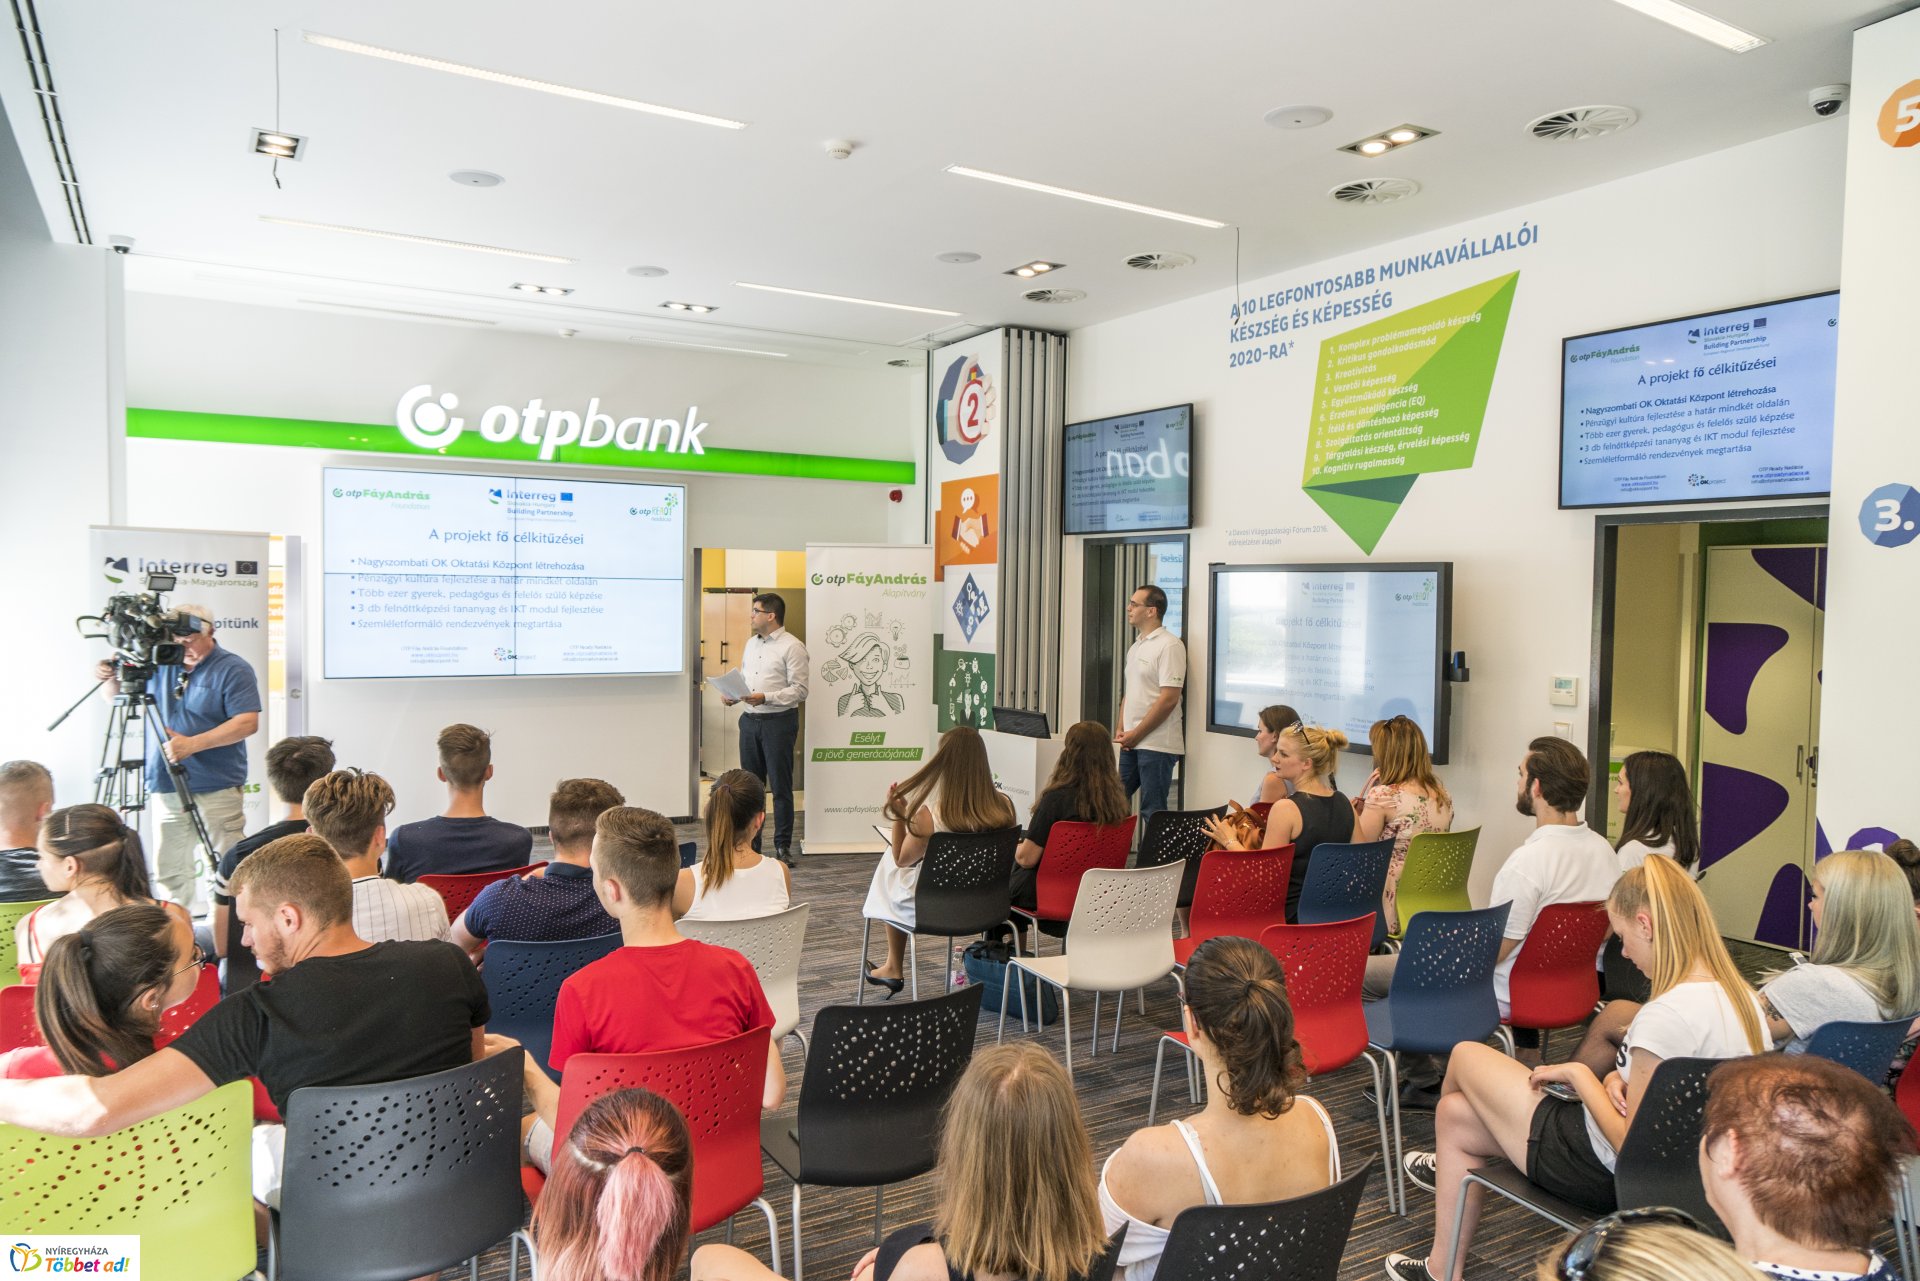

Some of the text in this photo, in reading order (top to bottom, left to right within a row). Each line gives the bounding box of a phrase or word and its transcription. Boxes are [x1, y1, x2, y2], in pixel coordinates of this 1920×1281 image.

[1242, 298, 1256, 315] 10
[1260, 268, 1375, 312] LEGFONTOSABB
[1380, 222, 1538, 281] MUNKAVÁLLALÓI
[1230, 289, 1392, 343] KÉSZSÉG ÉS KÉPESSÉG
[1338, 338, 1370, 353] Komplex
[1372, 320, 1446, 346] problémamegoldó
[1448, 312, 1481, 328] készség
[1338, 352, 1366, 366] Kritikus
[1368, 336, 1436, 361] gondolkodásmód
[1704, 341, 1729, 350] Building
[1730, 336, 1767, 346] Partnership
[1335, 363, 1376, 380] Kreativitás
[1638, 356, 1776, 386] A projekt fő célkitűzései
[1362, 374, 1396, 392] képesség
[1388, 384, 1418, 400] készség
[1358, 399, 1408, 416] intelligencia
[1409, 396, 1426, 408] (EQ)
[1586, 386, 1776, 416] Nagyszombati OK Oktatási Központ létrehozása
[968, 393, 979, 427] 2
[1586, 417, 1617, 428] Pénzügyi
[1619, 414, 1644, 424] kultúra
[1647, 410, 1685, 422] fejlesztése
[1695, 407, 1716, 416] határ
[1718, 402, 1754, 414] mindkét
[1756, 399, 1790, 409] oldalán
[1347, 422, 1354, 430] és
[1356, 416, 1400, 430] döntéshozó
[1402, 408, 1440, 424] képesség
[1652, 422, 1694, 435] pedagógus
[1708, 418, 1733, 428] felelős
[1736, 416, 1757, 424] szülő
[1760, 412, 1795, 424] képzése
[480, 396, 708, 460] otpbank
[1374, 425, 1424, 441] orientáltság
[1326, 447, 1363, 460] Tárgyalási
[1398, 434, 1430, 450] érvelési
[1432, 432, 1470, 446] képesség
[1592, 444, 1600, 452] db
[1604, 440, 1652, 450] felnőttképzési
[1656, 436, 1692, 446] tananyag
[1704, 432, 1718, 441] IKT
[1720, 430, 1749, 440] modul
[1752, 426, 1796, 438] fejlesztése
[1584, 444, 1752, 464] Szemléletformáló rendezvények megtartása
[1355, 456, 1406, 471] rugalmasság
[507, 488, 556, 502] Interreg
[507, 508, 574, 518] Building Partnership
[1874, 500, 1914, 533] 3.
[428, 529, 584, 545] A projekt fő célkitűzései
[358, 557, 584, 570] Nagyszombati OK Oktatási Központ létrehozása
[358, 574, 402, 584] Pénzügyi
[406, 574, 438, 584] kultúra
[442, 575, 488, 586] fejlesztése
[500, 576, 524, 584] határ
[526, 577, 562, 586] mindkét
[566, 578, 598, 586] oldalán
[826, 572, 927, 586] otpFáyAndrás
[358, 588, 384, 598] Több
[450, 590, 498, 600] pedagógus
[502, 590, 510, 598] és
[514, 590, 542, 599] felelős
[546, 591, 566, 600] szülő
[570, 592, 603, 601] képzése
[882, 588, 926, 598] Alapítvány
[358, 604, 364, 612] 3
[368, 604, 380, 612] db
[384, 604, 450, 614] felnőttképzési
[453, 605, 496, 614] tananyag
[499, 605, 508, 613] és
[530, 606, 558, 614] modul
[562, 606, 604, 616] fejlesztése
[358, 619, 562, 630] Szemléletformáló rendezvények megtartása
[854, 732, 880, 745] Esélyt
[824, 750, 844, 760] jövő
[846, 748, 918, 760] generációjának!
